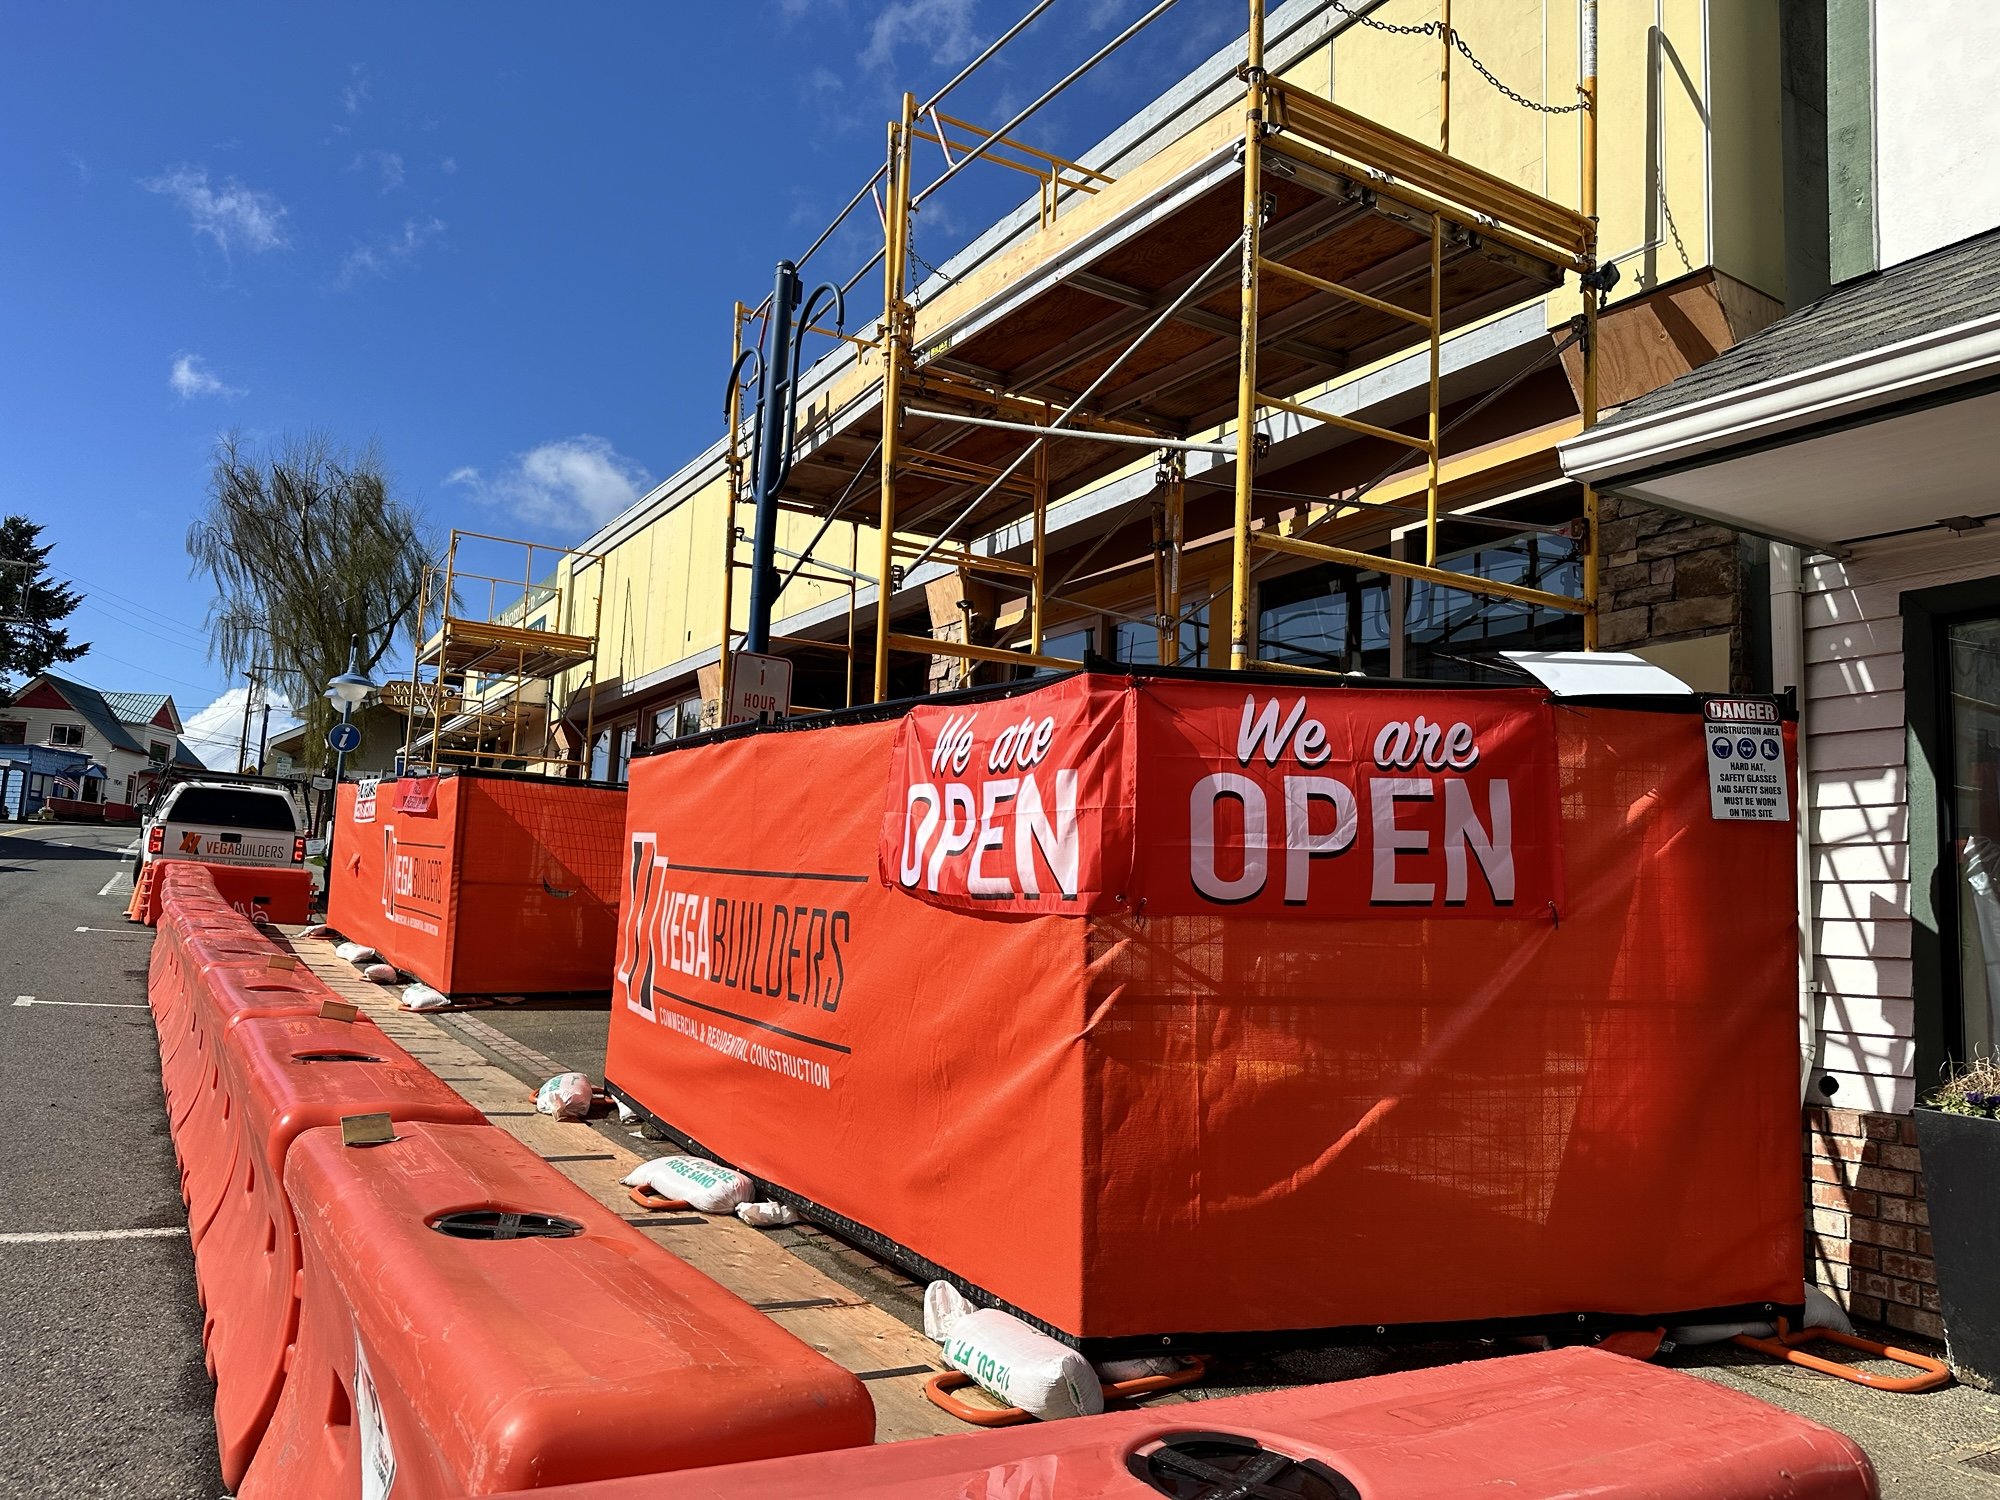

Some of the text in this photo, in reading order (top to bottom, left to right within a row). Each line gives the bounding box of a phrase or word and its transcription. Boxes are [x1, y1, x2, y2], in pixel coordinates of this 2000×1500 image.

[760, 669, 765, 686] 1
[743, 692, 776, 711] HOUR
[1709, 702, 1775, 721] DANGER
[1237, 693, 1481, 772] We are
[1708, 725, 1780, 737] CONSTRUCTION AREA
[931, 712, 1055, 777] We are
[1730, 762, 1766, 772] HARD HAT,
[1716, 784, 1782, 795] AND SAFETY SHOES
[1719, 773, 1777, 784] SAFETY GLASSES
[1723, 796, 1777, 807] MUST BE WORN
[1729, 808, 1774, 818] ON THIS SITE
[900, 768, 1078, 900] OPEN
[1188, 772, 1517, 908] OPEN
[206, 841, 285, 859] VEGABUILDERS
[660, 889, 850, 1013] VEGABUILDERS
[659, 1006, 831, 1090] COMMERCIAL & RESIDENTIAL CONSTRUCTION
[665, 1159, 717, 1189] ROSE SAND
[953, 1339, 975, 1367] FT.
[976, 1351, 996, 1383] CU.
[996, 1366, 1011, 1392] 1/2
